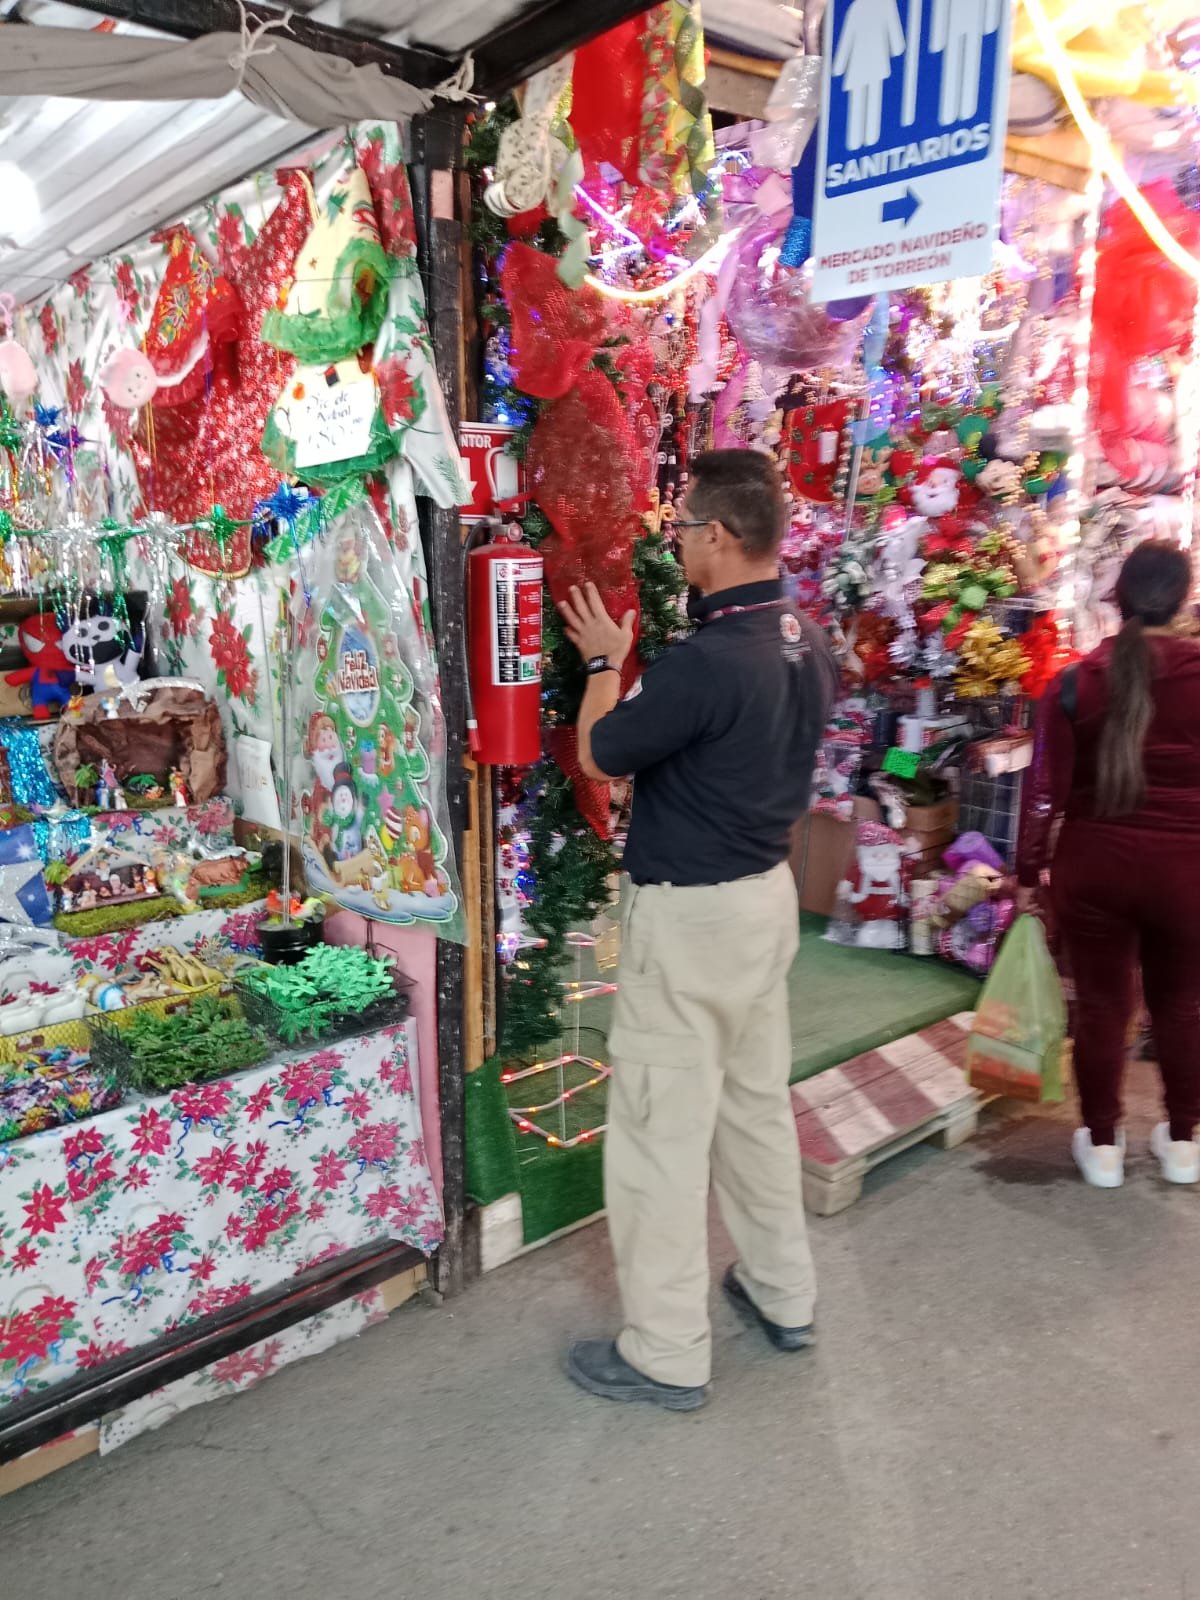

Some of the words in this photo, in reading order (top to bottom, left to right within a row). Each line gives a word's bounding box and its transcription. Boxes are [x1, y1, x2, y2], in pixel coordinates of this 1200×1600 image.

[826, 122, 991, 189] SANITARIOS
[819, 242, 896, 270] MERCADO
[900, 222, 988, 254] NAVIDEÑO
[848, 268, 870, 285] DE
[874, 250, 952, 279] TORREÓN
